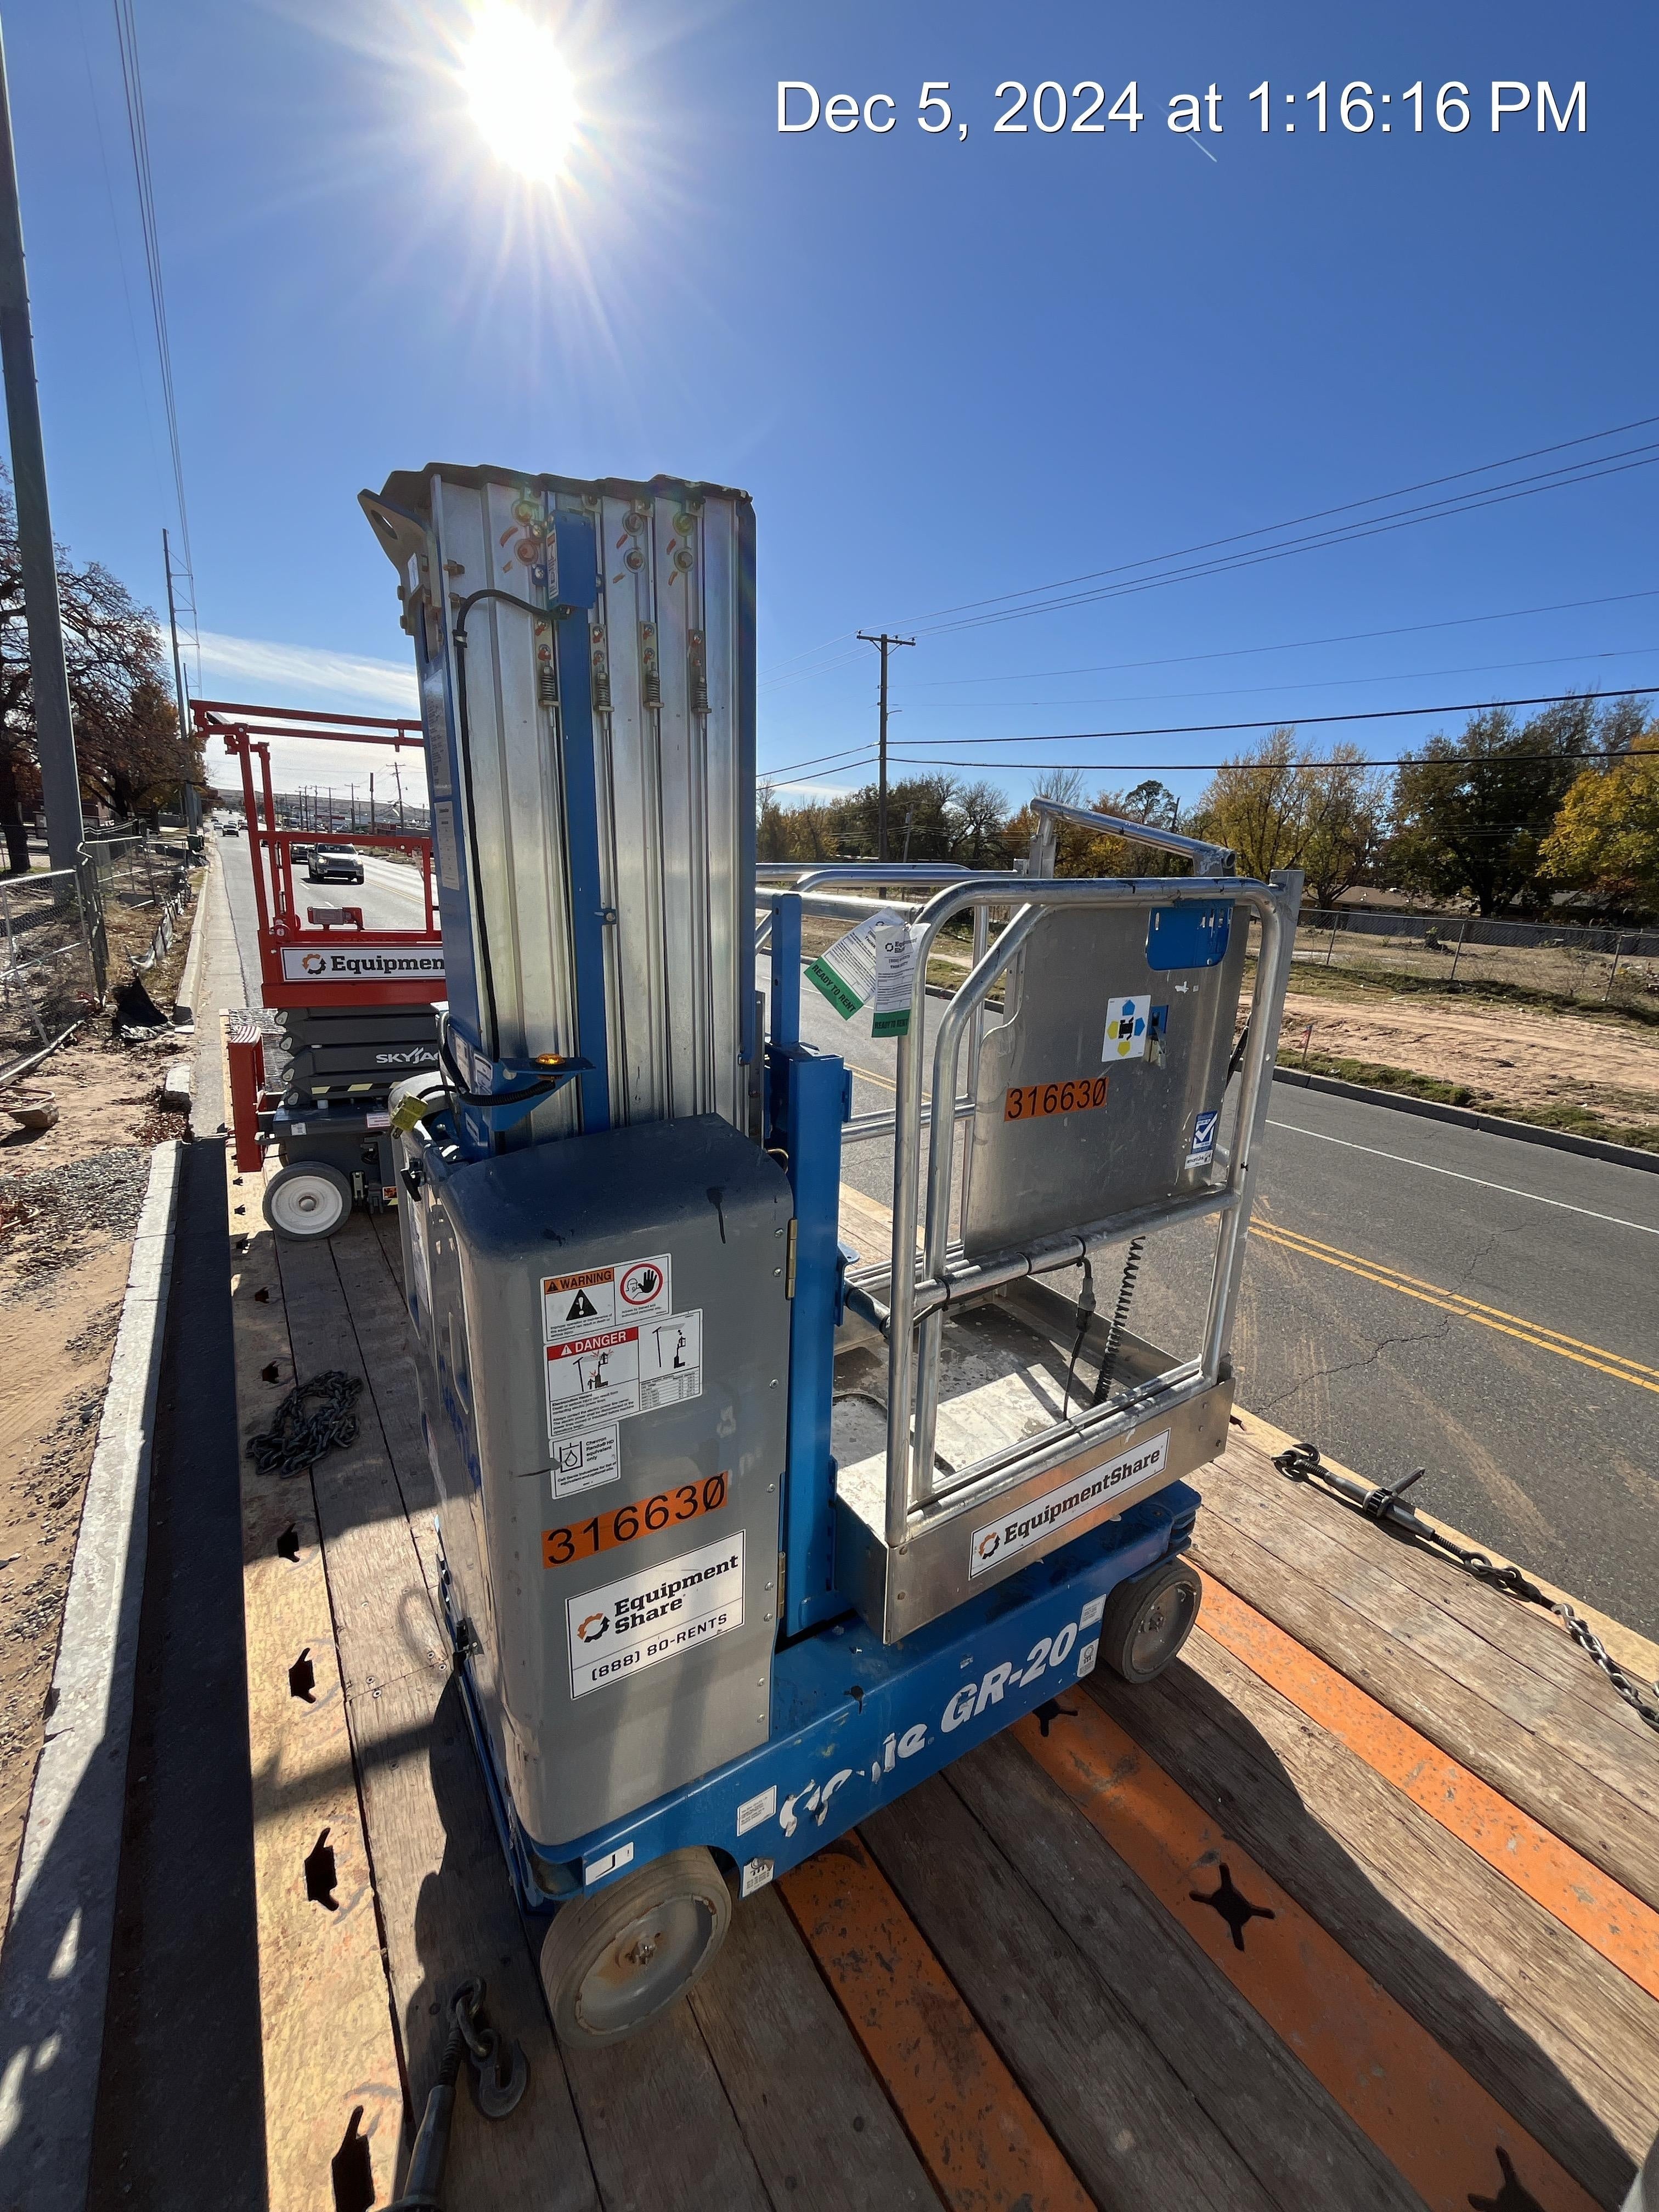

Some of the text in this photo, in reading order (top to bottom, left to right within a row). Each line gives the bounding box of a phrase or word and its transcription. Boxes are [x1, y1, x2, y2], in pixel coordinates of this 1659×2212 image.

[330, 955, 445, 975] Equipmen
[811, 964, 856, 1012] READY TO RENT
[874, 1020, 889, 1029] READY
[889, 1020, 896, 1028] TO
[1007, 1076, 1107, 1119] 316630
[560, 1271, 612, 1290] WARNING
[575, 1331, 627, 1353] DANGER
[585, 1437, 607, 1446] Chevron
[586, 1445, 612, 1457] equivalent
[1003, 1448, 1160, 1546] EquipmentShare
[546, 1472, 725, 1565] 316630
[614, 1554, 739, 1617] Equipment
[614, 1598, 684, 1634] Share
[591, 1613, 728, 1681] (888) 80-RENTS
[940, 1622, 1078, 1734] GR-20
